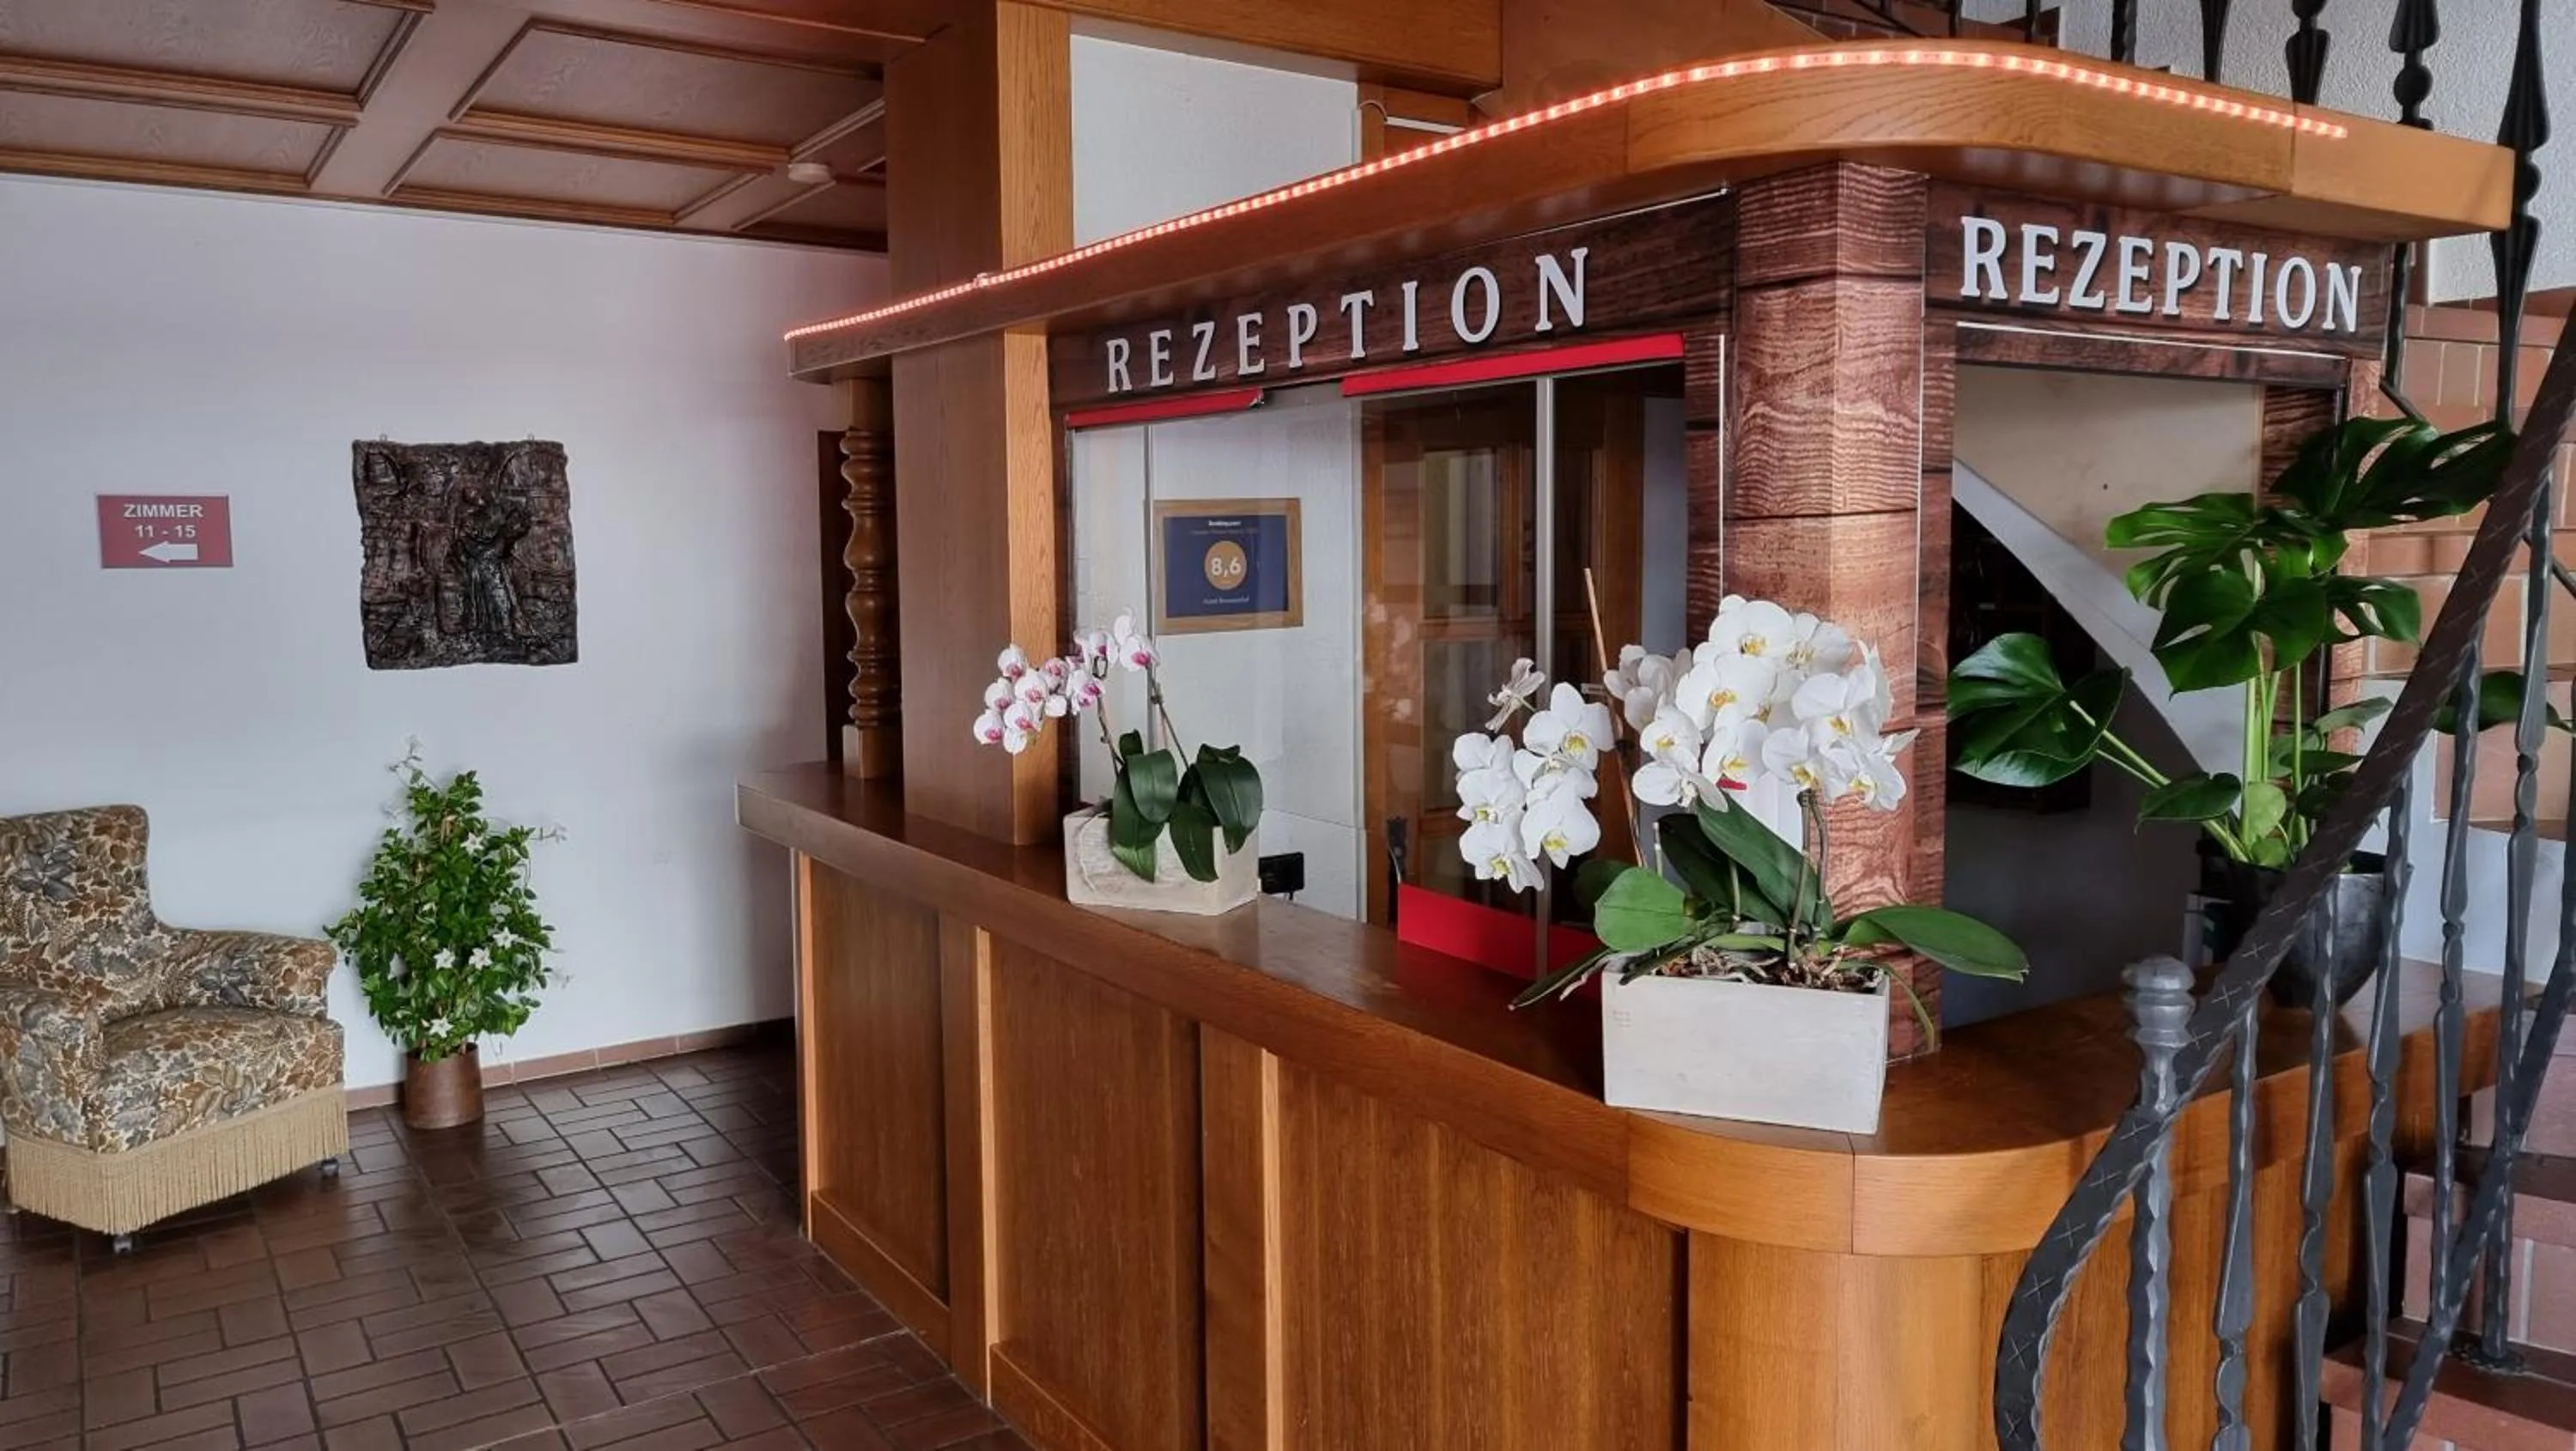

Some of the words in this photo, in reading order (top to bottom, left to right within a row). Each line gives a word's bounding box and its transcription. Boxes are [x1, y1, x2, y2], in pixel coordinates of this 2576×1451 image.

[1960, 216, 2363, 333] REZEPTION
[1106, 247, 1589, 392] REZEPTION
[123, 504, 204, 518] ZIMMER
[135, 525, 155, 538] 11
[174, 525, 196, 538] 15
[1211, 557, 1242, 577] 8,6
